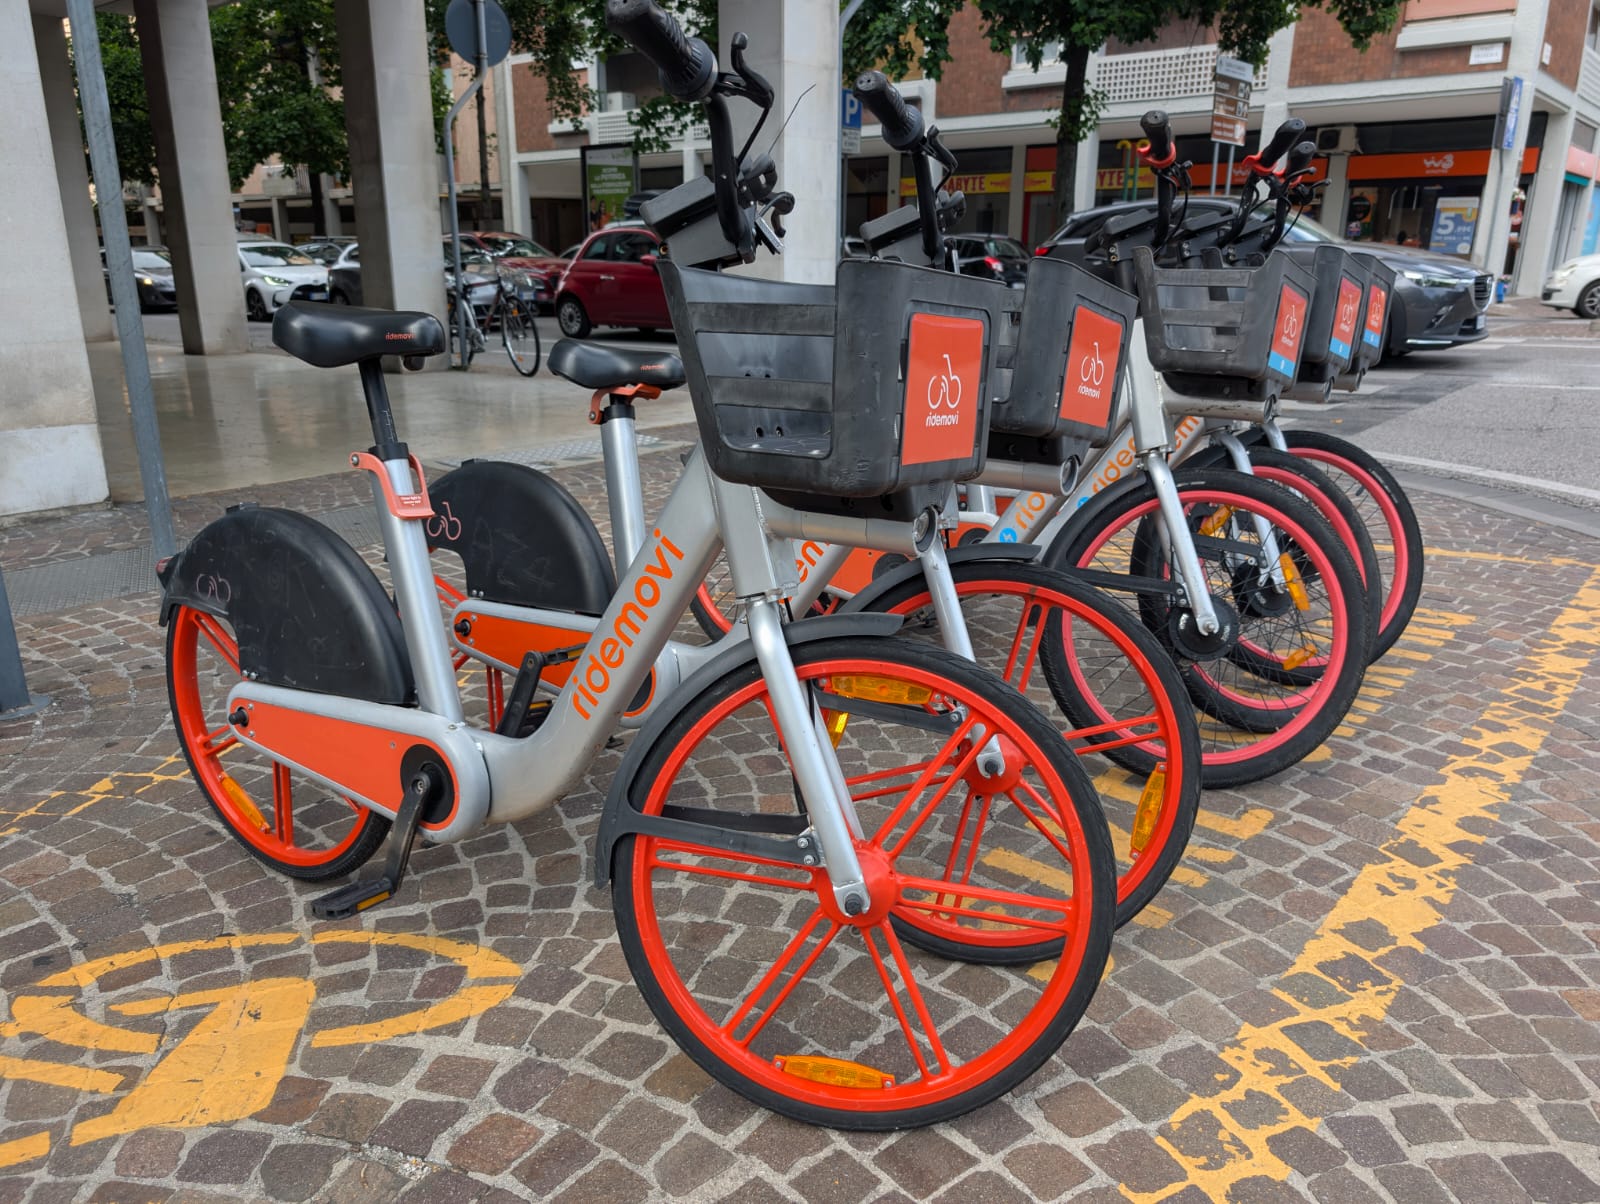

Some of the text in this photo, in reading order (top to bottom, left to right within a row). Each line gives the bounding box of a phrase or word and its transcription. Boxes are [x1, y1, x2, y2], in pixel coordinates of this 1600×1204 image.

[845, 93, 858, 123] P
[1078, 383, 1101, 400] ridemovi
[926, 411, 959, 427] ridemovi
[572, 527, 684, 721] ridemovi
